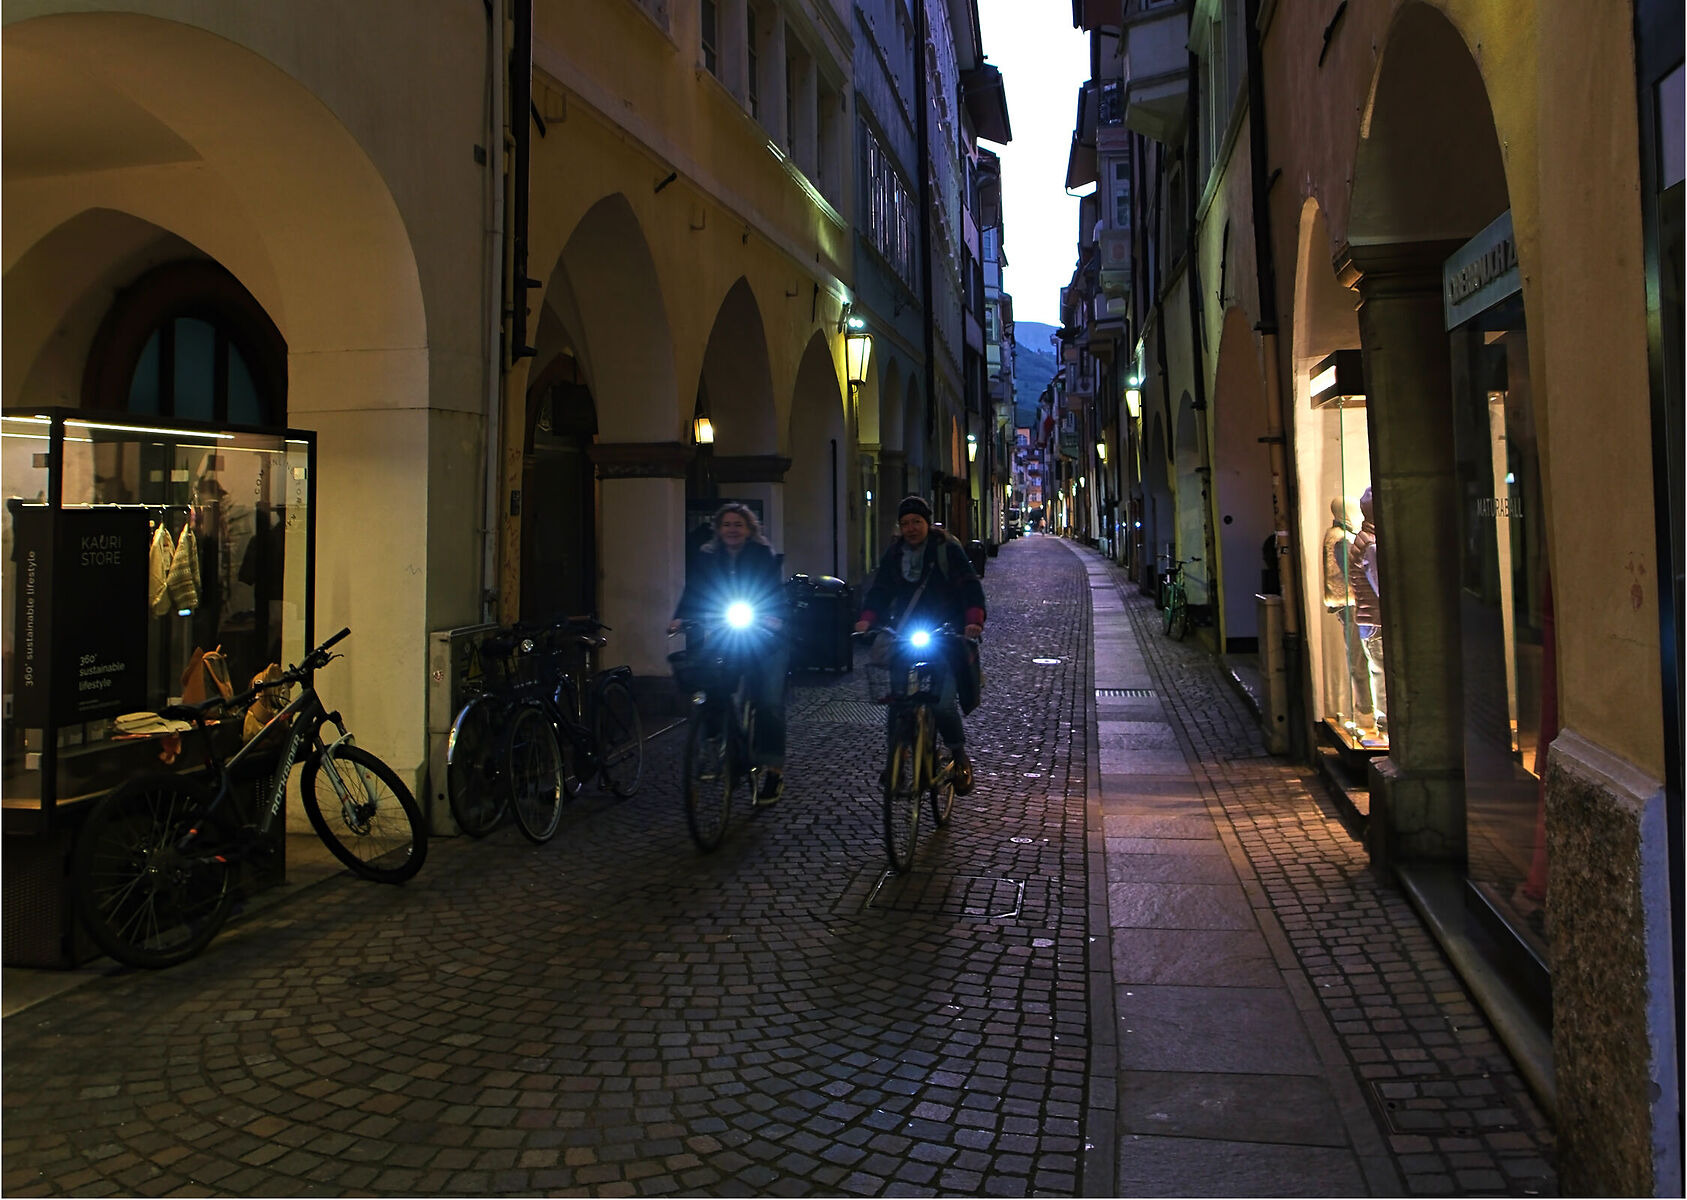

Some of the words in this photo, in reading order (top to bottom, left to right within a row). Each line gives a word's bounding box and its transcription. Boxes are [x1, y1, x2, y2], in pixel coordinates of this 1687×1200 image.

[1476, 497, 1524, 518] MATURABALL
[81, 535, 121, 550] KAURI
[81, 551, 121, 567] STORE
[26, 551, 38, 595] lifestyle
[25, 598, 35, 660] sustainable
[79, 661, 126, 677] sustainable
[78, 678, 112, 692] lifestyle
[271, 733, 301, 816] ROCKRIDER
